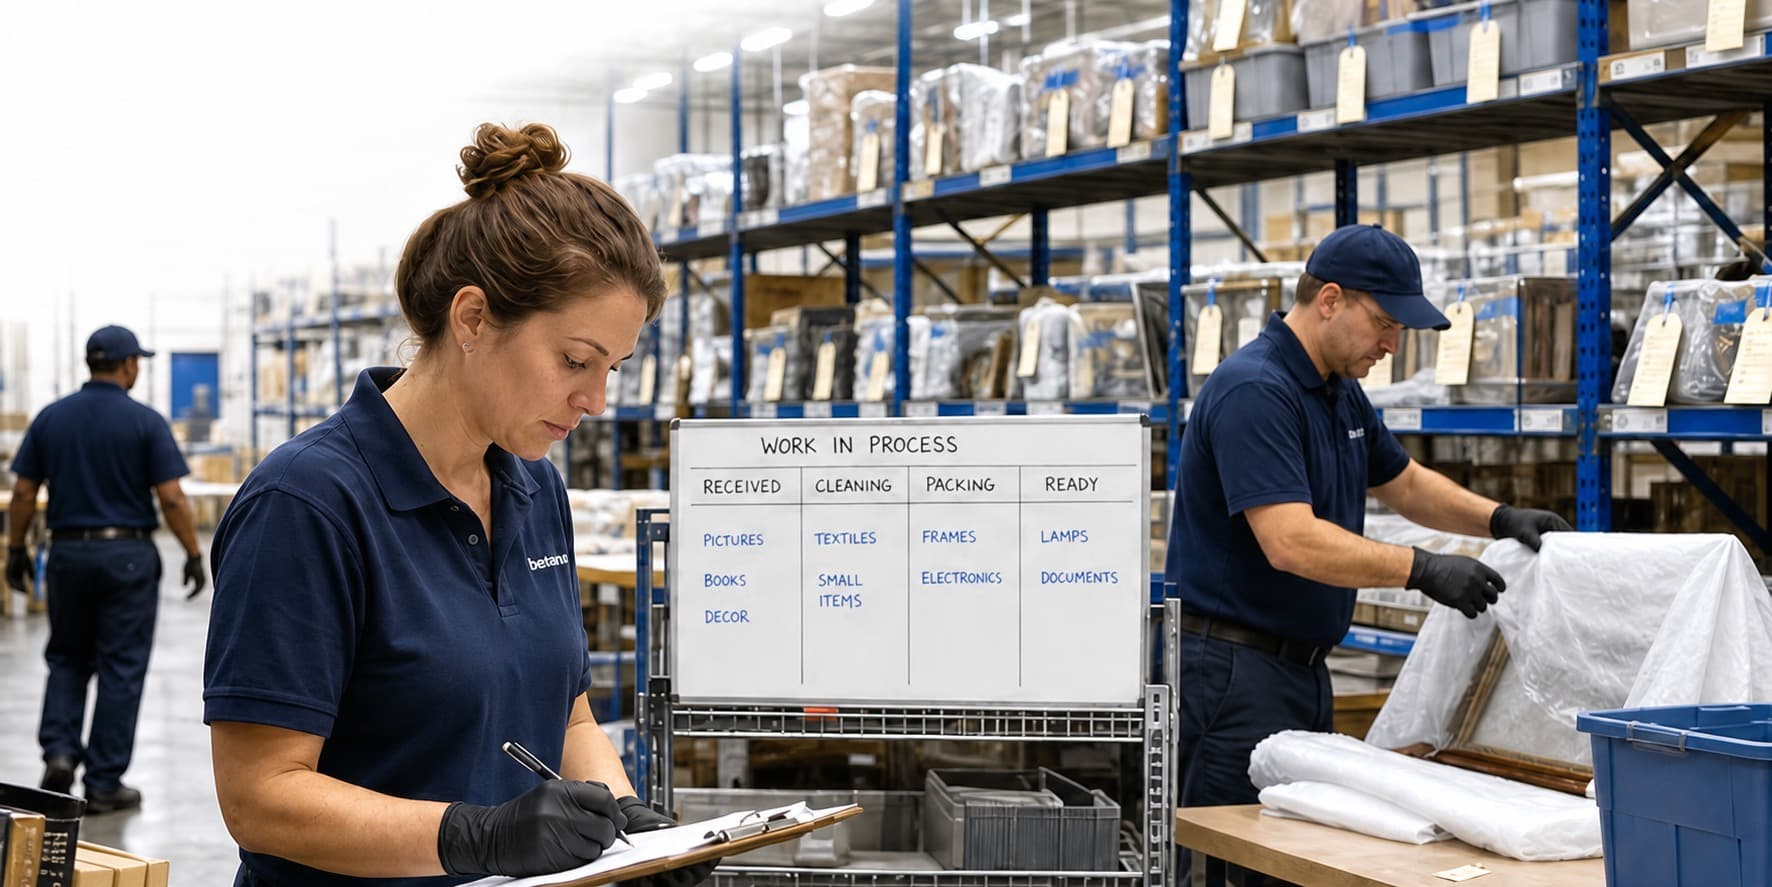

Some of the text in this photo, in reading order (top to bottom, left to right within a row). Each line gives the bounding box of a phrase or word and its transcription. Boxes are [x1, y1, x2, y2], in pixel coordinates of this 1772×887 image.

[760, 434, 958, 455] WORK IN PROCESS
[703, 478, 782, 495] RECEIVED
[814, 478, 893, 494] CLEANING
[926, 475, 996, 493] PACKING
[1045, 475, 1099, 493] READY
[703, 532, 764, 548] PICTURES
[813, 531, 877, 546] TEXTILES
[922, 529, 977, 544] FRAMES
[1040, 529, 1089, 544] LAMPS
[704, 573, 747, 588] BOOKS
[818, 573, 864, 588] SMALL
[921, 570, 1003, 585] ELECTRONICS
[1040, 570, 1119, 585] DOCUMENTS
[819, 593, 863, 609] ITEMS
[704, 609, 750, 625] DECOR
